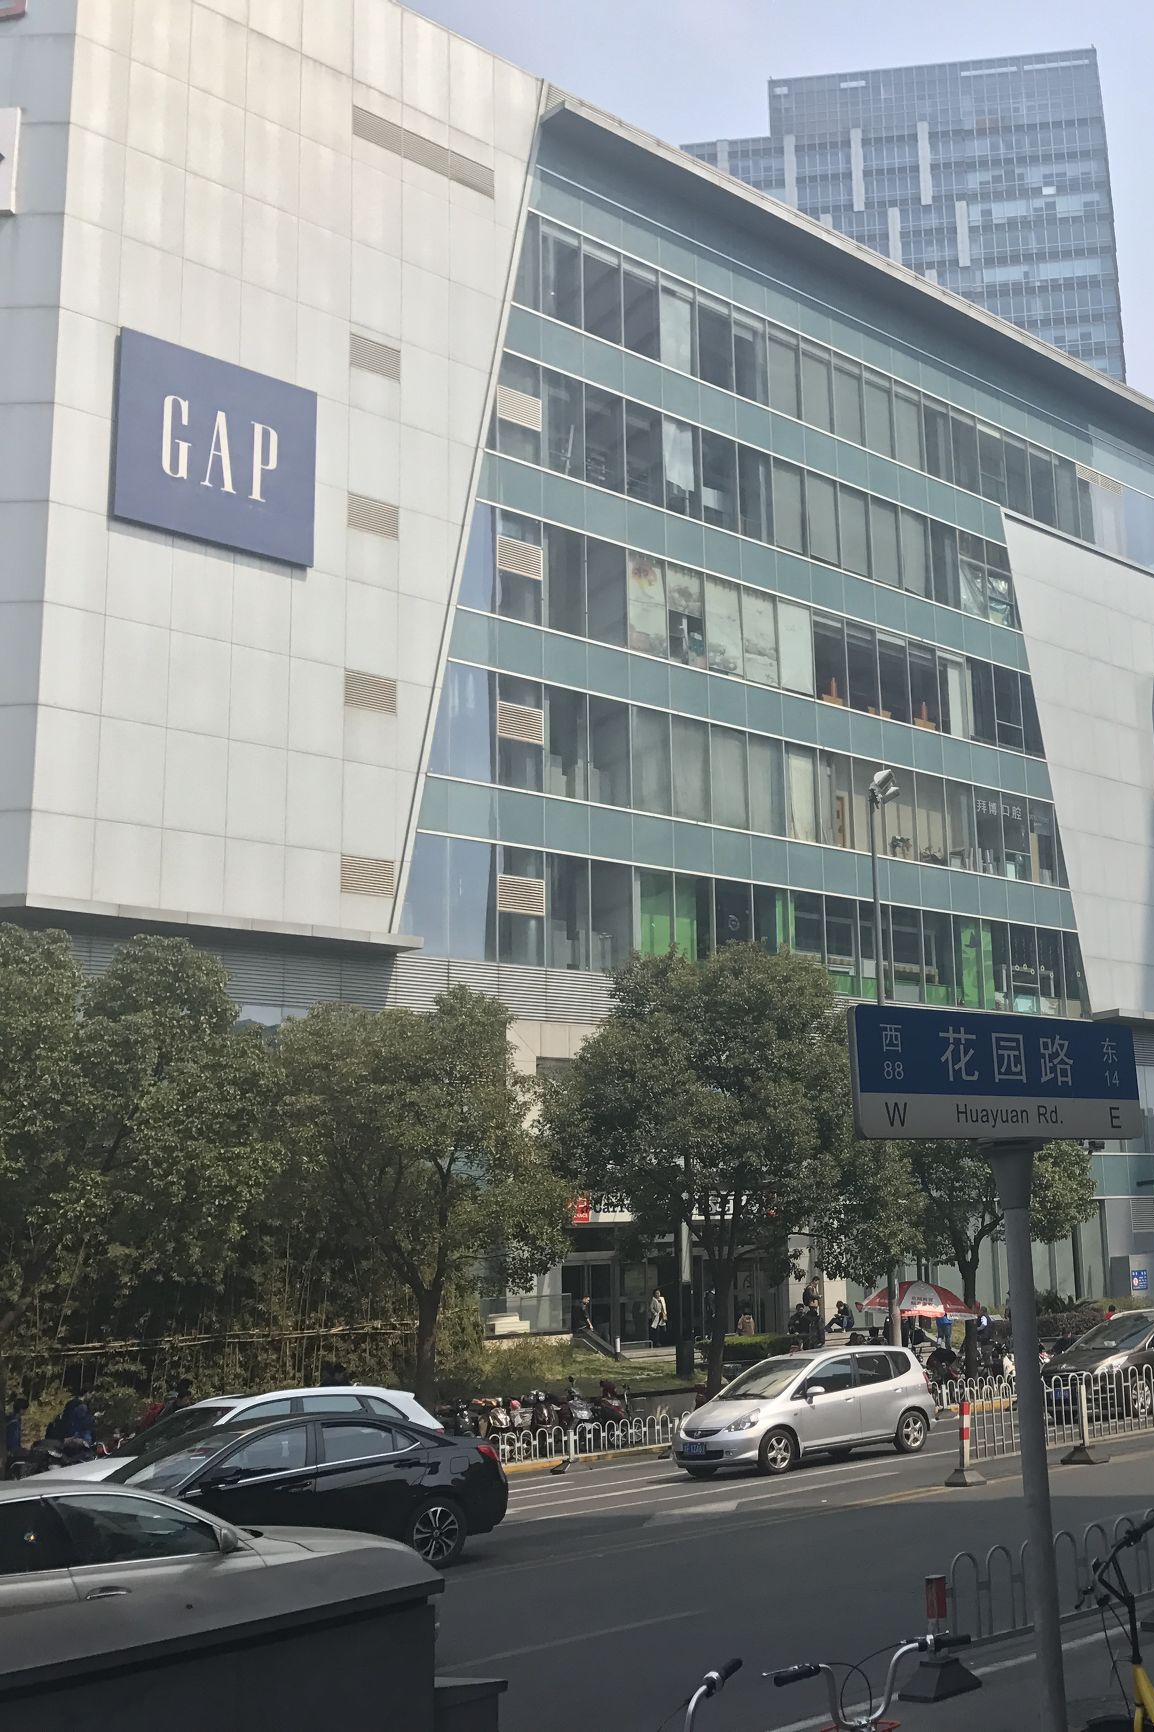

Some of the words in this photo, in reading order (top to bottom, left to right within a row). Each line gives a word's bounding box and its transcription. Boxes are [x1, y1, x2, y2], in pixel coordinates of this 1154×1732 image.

[161, 395, 279, 503] GAP
[976, 799, 1022, 820] 拜博口腔
[879, 1023, 902, 1053] 西
[938, 1026, 1074, 1087] 花园路
[1100, 1037, 1118, 1063] 东
[883, 1060, 904, 1080] 88
[1104, 1070, 1120, 1088] 14
[884, 1101, 908, 1128] W
[956, 1103, 1029, 1128] Huayuan
[1037, 1104, 1064, 1125] Rd.
[1109, 1106, 1122, 1129] E
